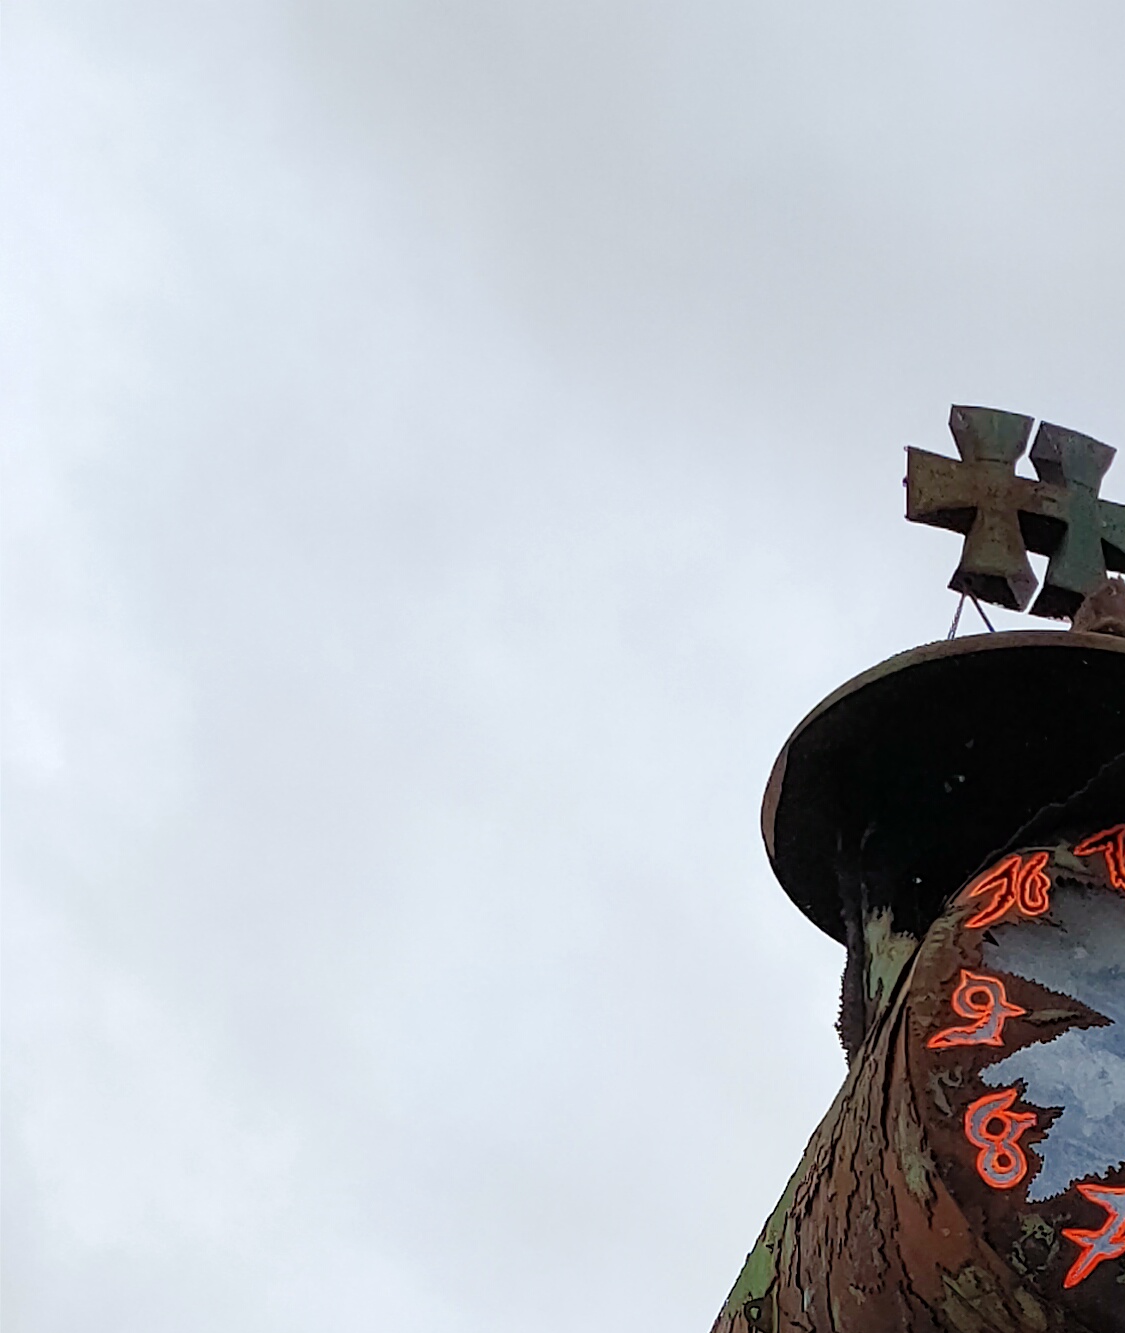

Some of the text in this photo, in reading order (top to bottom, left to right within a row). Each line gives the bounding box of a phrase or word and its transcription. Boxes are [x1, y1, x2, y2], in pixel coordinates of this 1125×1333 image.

[964, 851, 1051, 929] 10
[927, 968, 1026, 1049] 9
[964, 1088, 1037, 1189] 8
